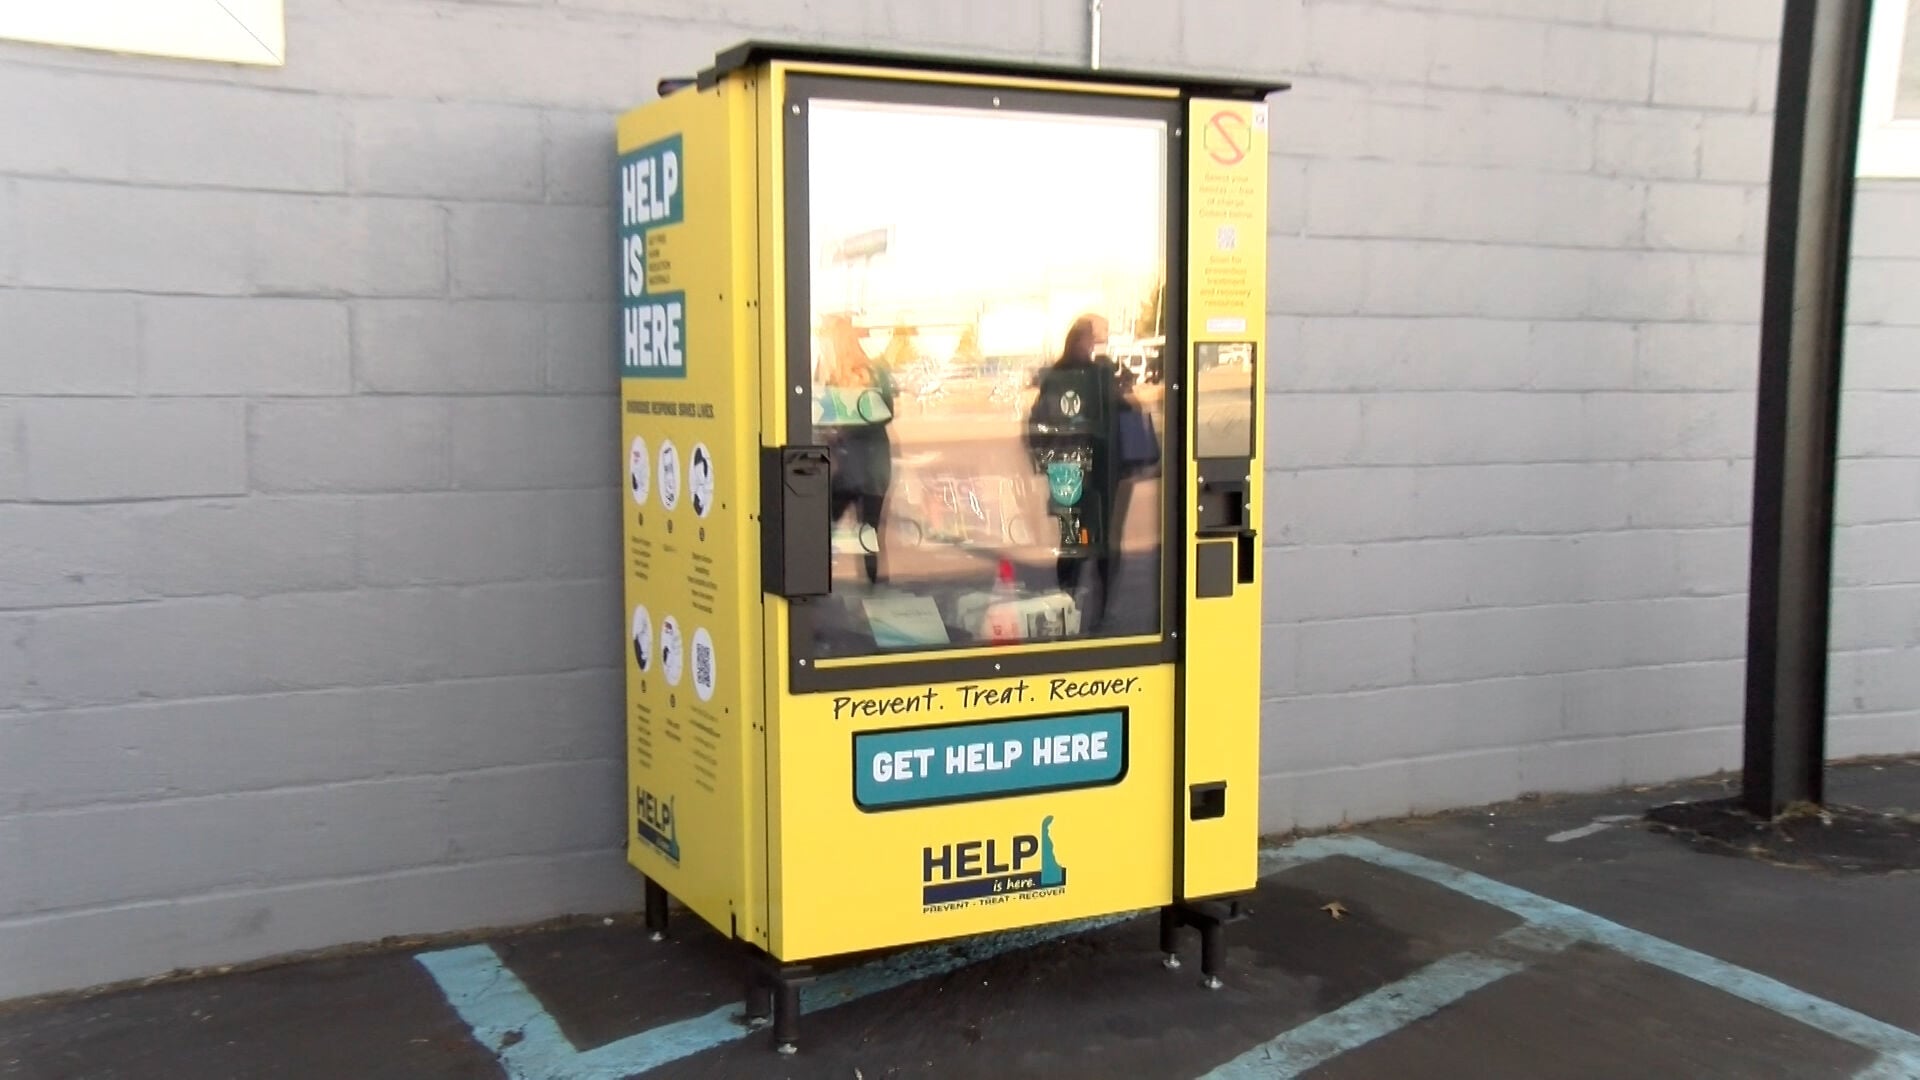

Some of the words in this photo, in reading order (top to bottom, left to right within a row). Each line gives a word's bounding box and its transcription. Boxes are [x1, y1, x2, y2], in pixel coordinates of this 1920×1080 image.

[622, 150, 678, 227] HELP
[624, 234, 643, 298] IS
[624, 302, 682, 367] HERE
[834, 687, 944, 720] Prevent.
[956, 680, 1035, 710] Treat.
[1049, 676, 1143, 701] Recover.
[872, 747, 935, 783] GET
[945, 740, 1022, 774] HELP
[1032, 731, 1108, 766] HERE
[636, 785, 670, 831] HELP
[922, 834, 1038, 882] HELP
[923, 902, 969, 914] PREVENT
[980, 895, 1010, 906] TREAT
[1019, 888, 1066, 900] RECOVER
[993, 879, 1002, 892] is
